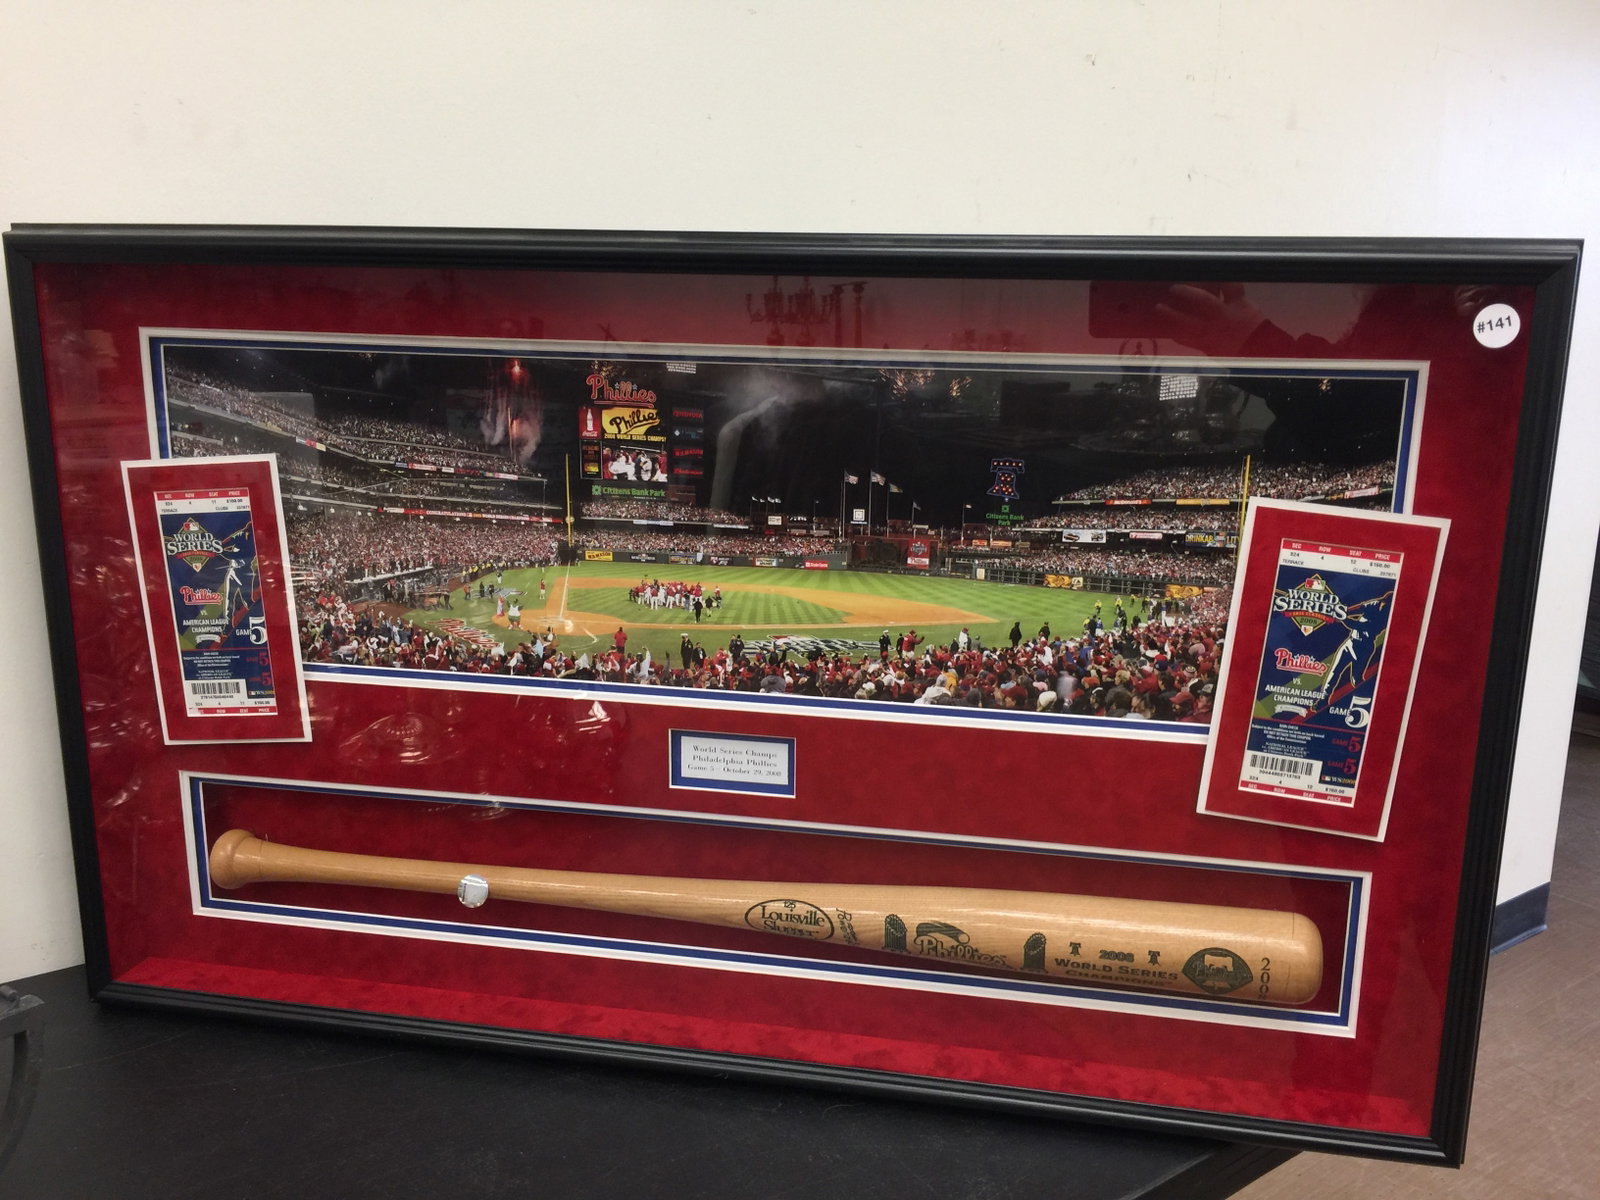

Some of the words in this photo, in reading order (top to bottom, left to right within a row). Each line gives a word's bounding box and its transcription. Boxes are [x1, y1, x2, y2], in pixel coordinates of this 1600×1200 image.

[1477, 315, 1512, 333] #141
[586, 373, 657, 408] Phillies
[632, 488, 648, 496] Bank
[173, 533, 213, 542] WORLD
[167, 540, 223, 555] SERIES
[180, 586, 223, 605] Phillies
[1288, 588, 1340, 604] WORLD
[1273, 595, 1347, 620] SERIES
[1300, 617, 1317, 625] 2008
[249, 617, 267, 644] 5
[258, 652, 269, 666] 5
[1274, 647, 1328, 676] Phillies
[261, 672, 271, 686] 5
[1265, 684, 1301, 696] AMERICAN
[1301, 690, 1326, 700] LEAGUE
[1274, 694, 1314, 706] CHAMPIONS
[1345, 695, 1371, 728] 5
[693, 745, 717, 753] World
[746, 749, 777, 759] Champs
[1347, 736, 1361, 753] 5
[693, 755, 743, 765] Philadelphia
[747, 759, 777, 767] Phillies
[1343, 759, 1357, 774] 5
[723, 767, 750, 775] October
[784, 900, 796, 909] 125
[761, 905, 825, 927] Louisville
[913, 935, 1006, 965] Phillies
[1099, 949, 1134, 963] 2008
[1054, 958, 1112, 972] WORLD
[1118, 966, 1178, 980] SERIES
